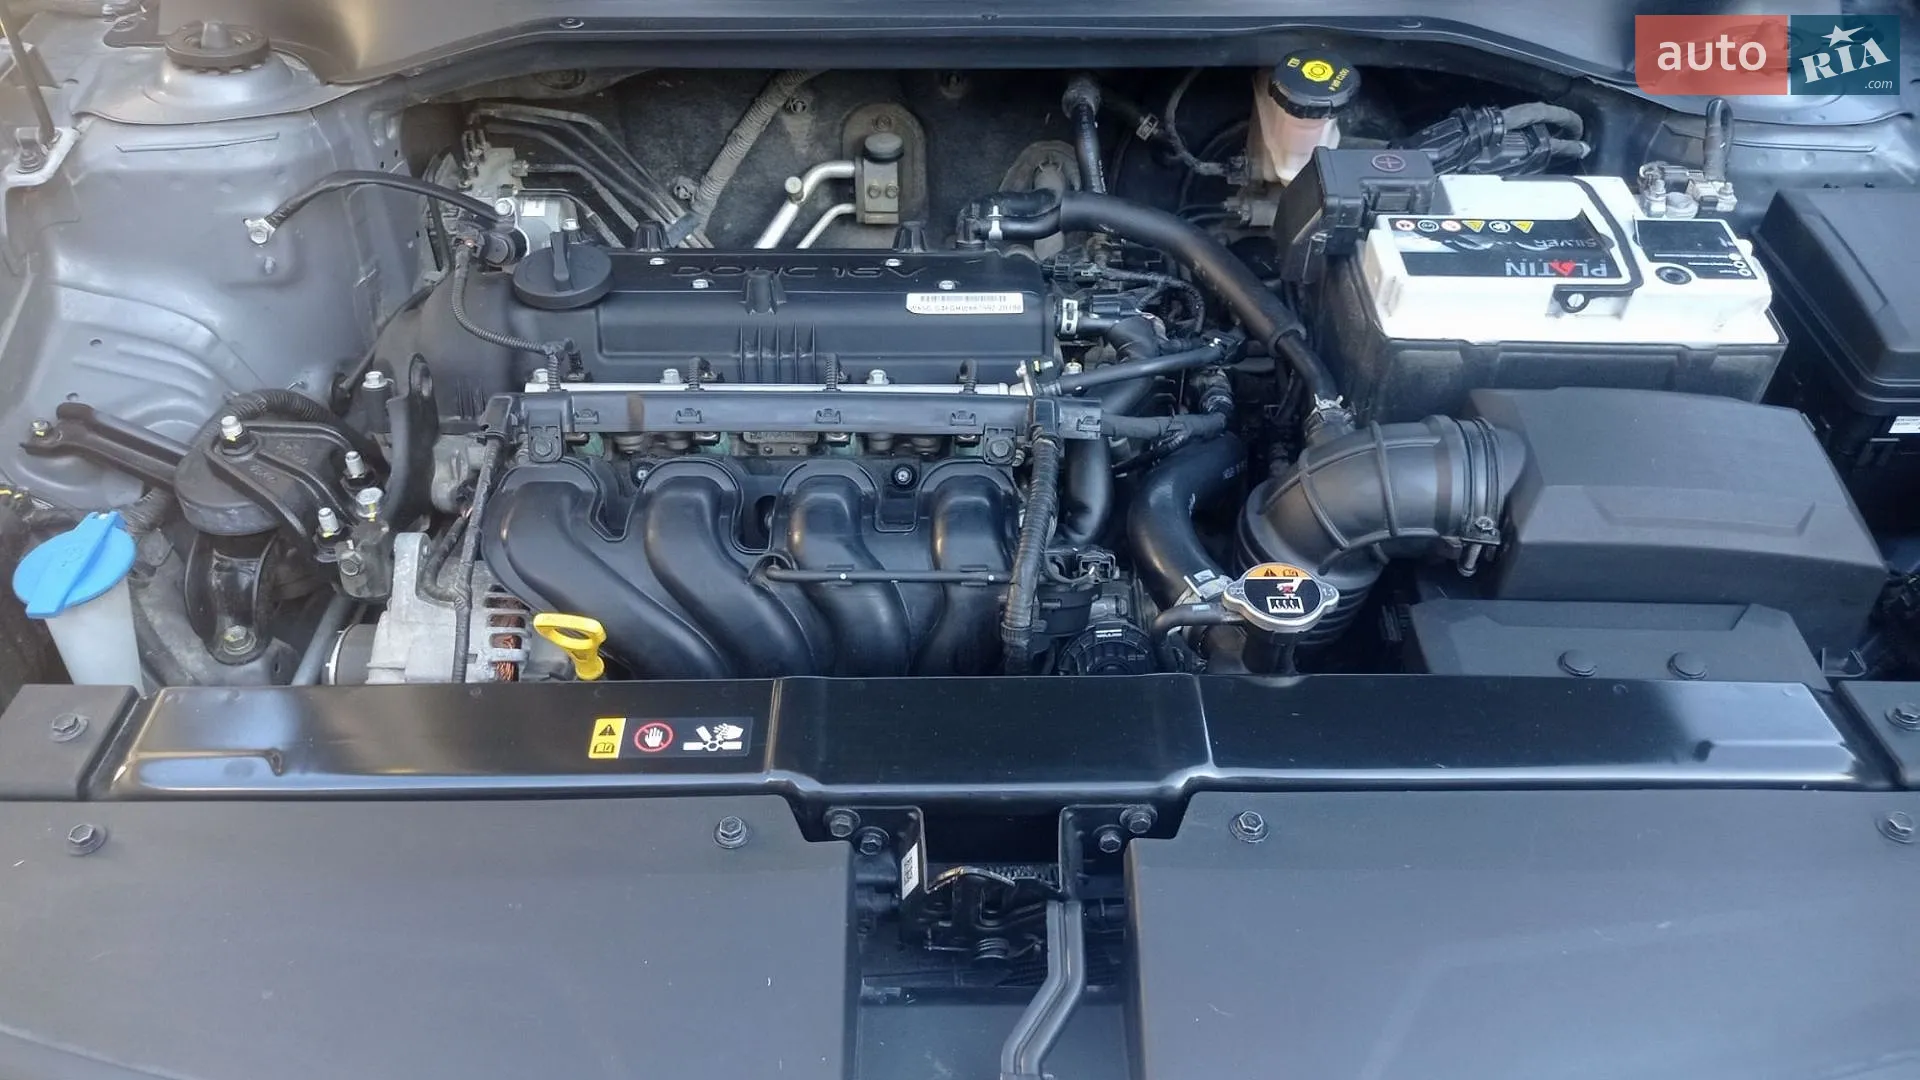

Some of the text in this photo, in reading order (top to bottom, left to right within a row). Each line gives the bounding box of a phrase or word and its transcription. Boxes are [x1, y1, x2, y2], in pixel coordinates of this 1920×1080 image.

[1534, 239, 1598, 249] SILVER
[832, 265, 928, 278] 16V
[1505, 260, 1607, 278] PLATIN
